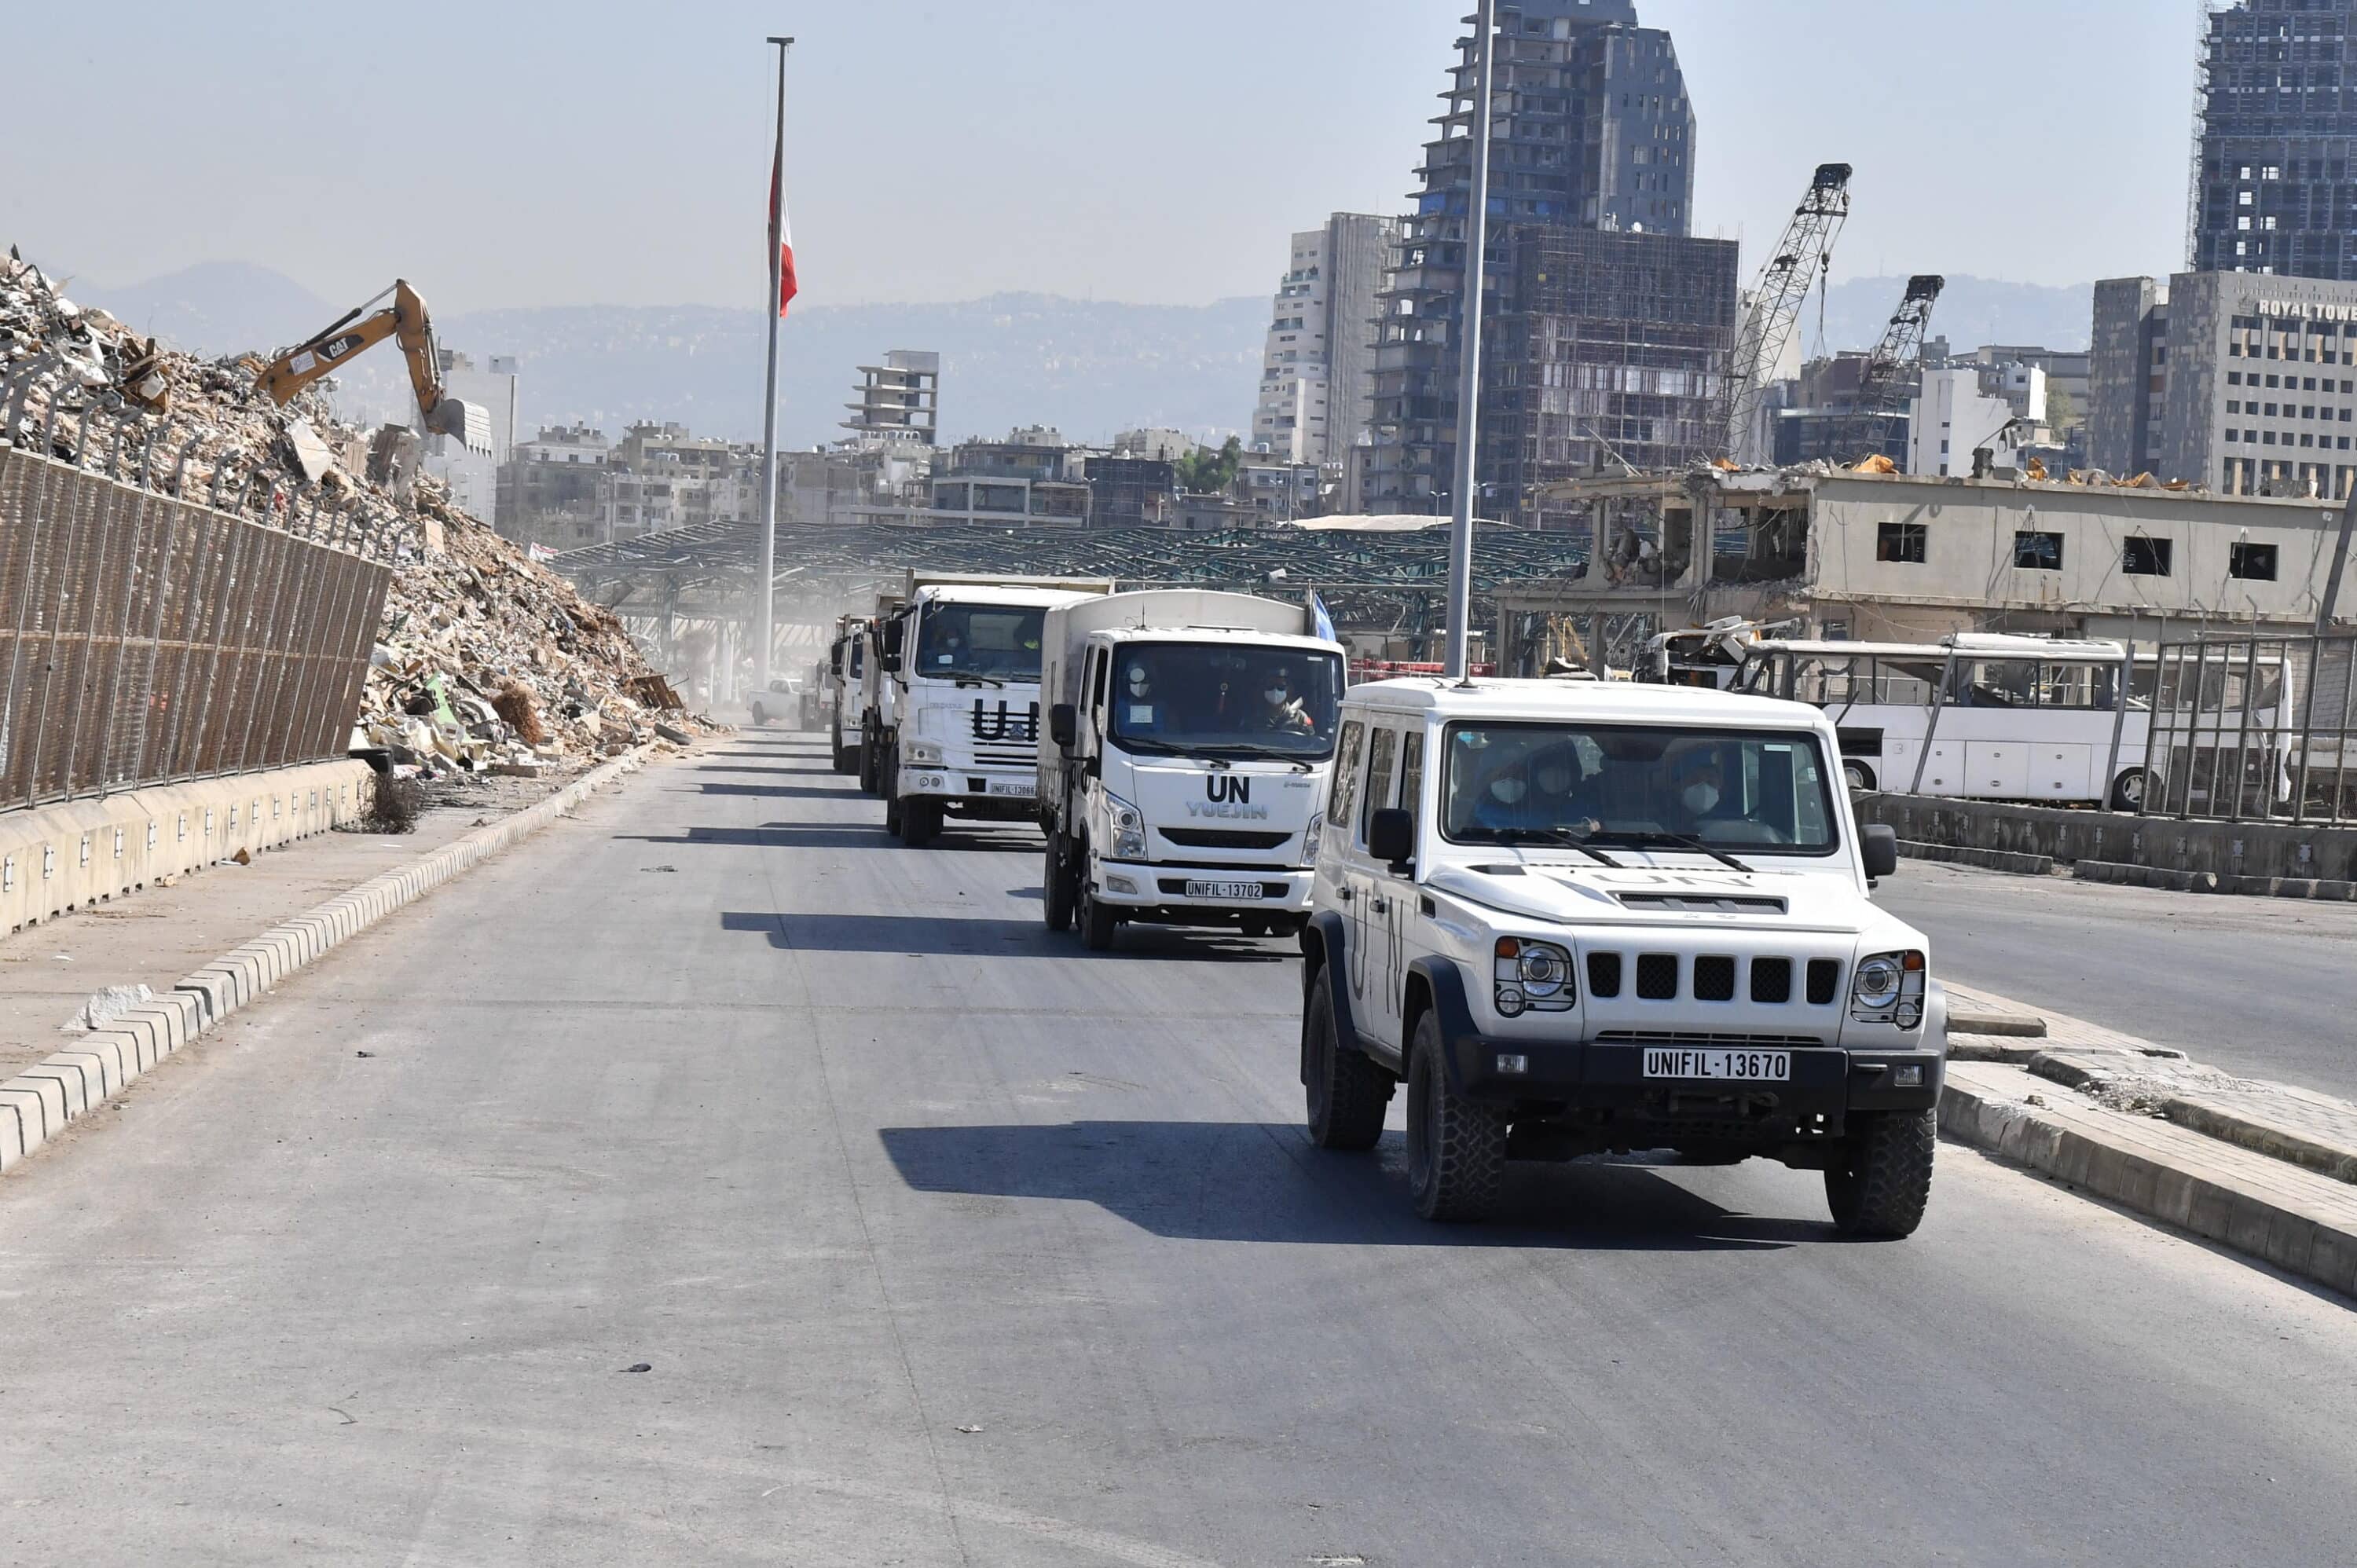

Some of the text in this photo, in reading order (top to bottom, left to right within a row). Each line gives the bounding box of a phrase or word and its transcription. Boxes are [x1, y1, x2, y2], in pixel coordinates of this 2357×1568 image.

[2259, 299, 2310, 317] ROYAL
[329, 338, 349, 357] CAT
[1207, 775, 1249, 804] UN
[1186, 801, 1268, 819] YUEJIN
[1187, 882, 1260, 897] UNIFIL-13702
[1590, 874, 1755, 888] UN
[1351, 885, 1403, 1019] UN
[1648, 1052, 1786, 1078] UNIFIL-13670
